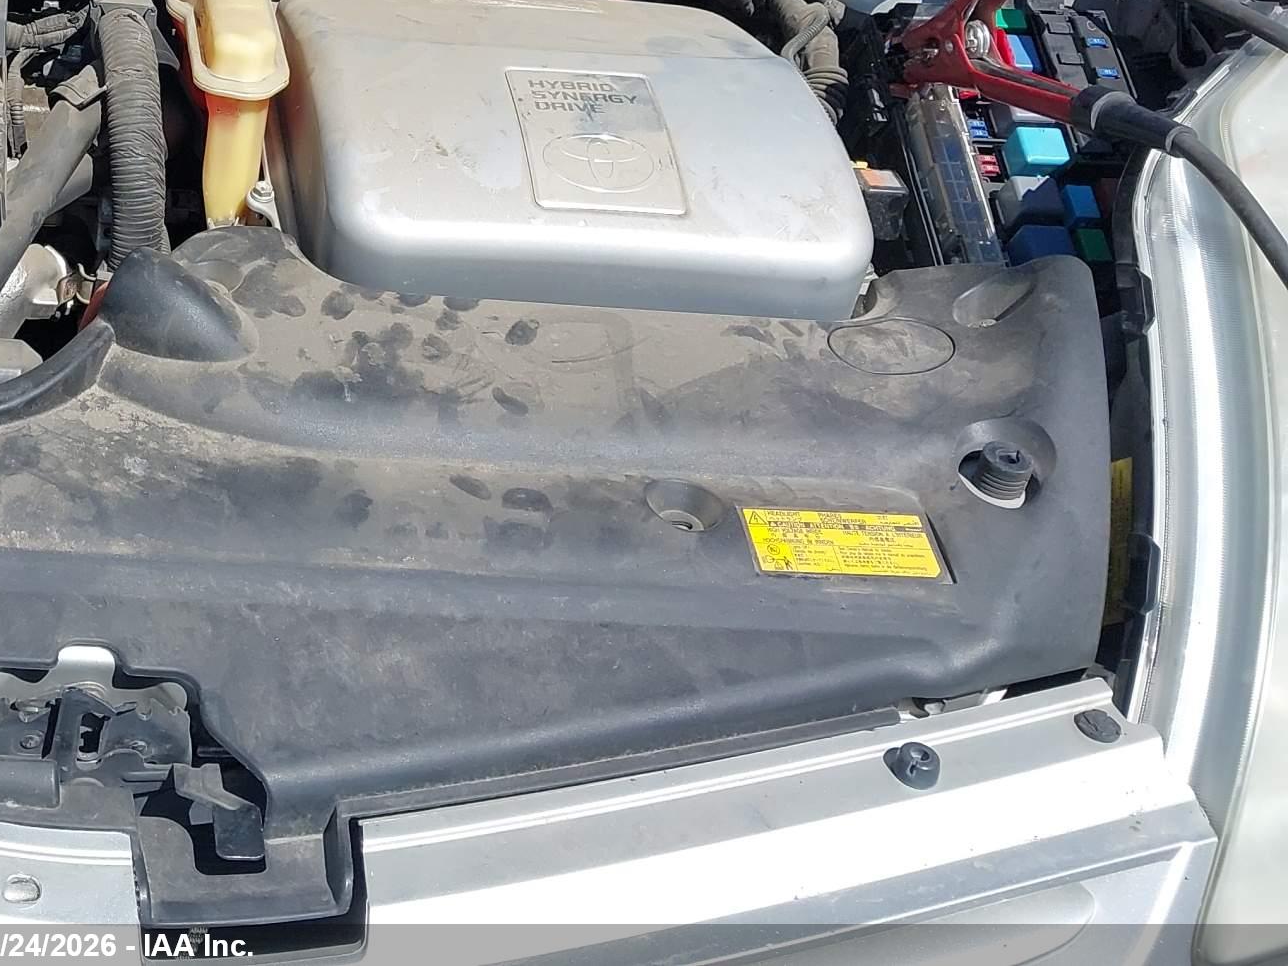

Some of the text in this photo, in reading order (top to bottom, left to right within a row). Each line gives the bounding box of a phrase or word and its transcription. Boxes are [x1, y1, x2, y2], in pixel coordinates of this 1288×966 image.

[528, 79, 616, 92] HYBRID
[531, 90, 638, 104] SYNERGY
[535, 101, 606, 114] DRIVE
